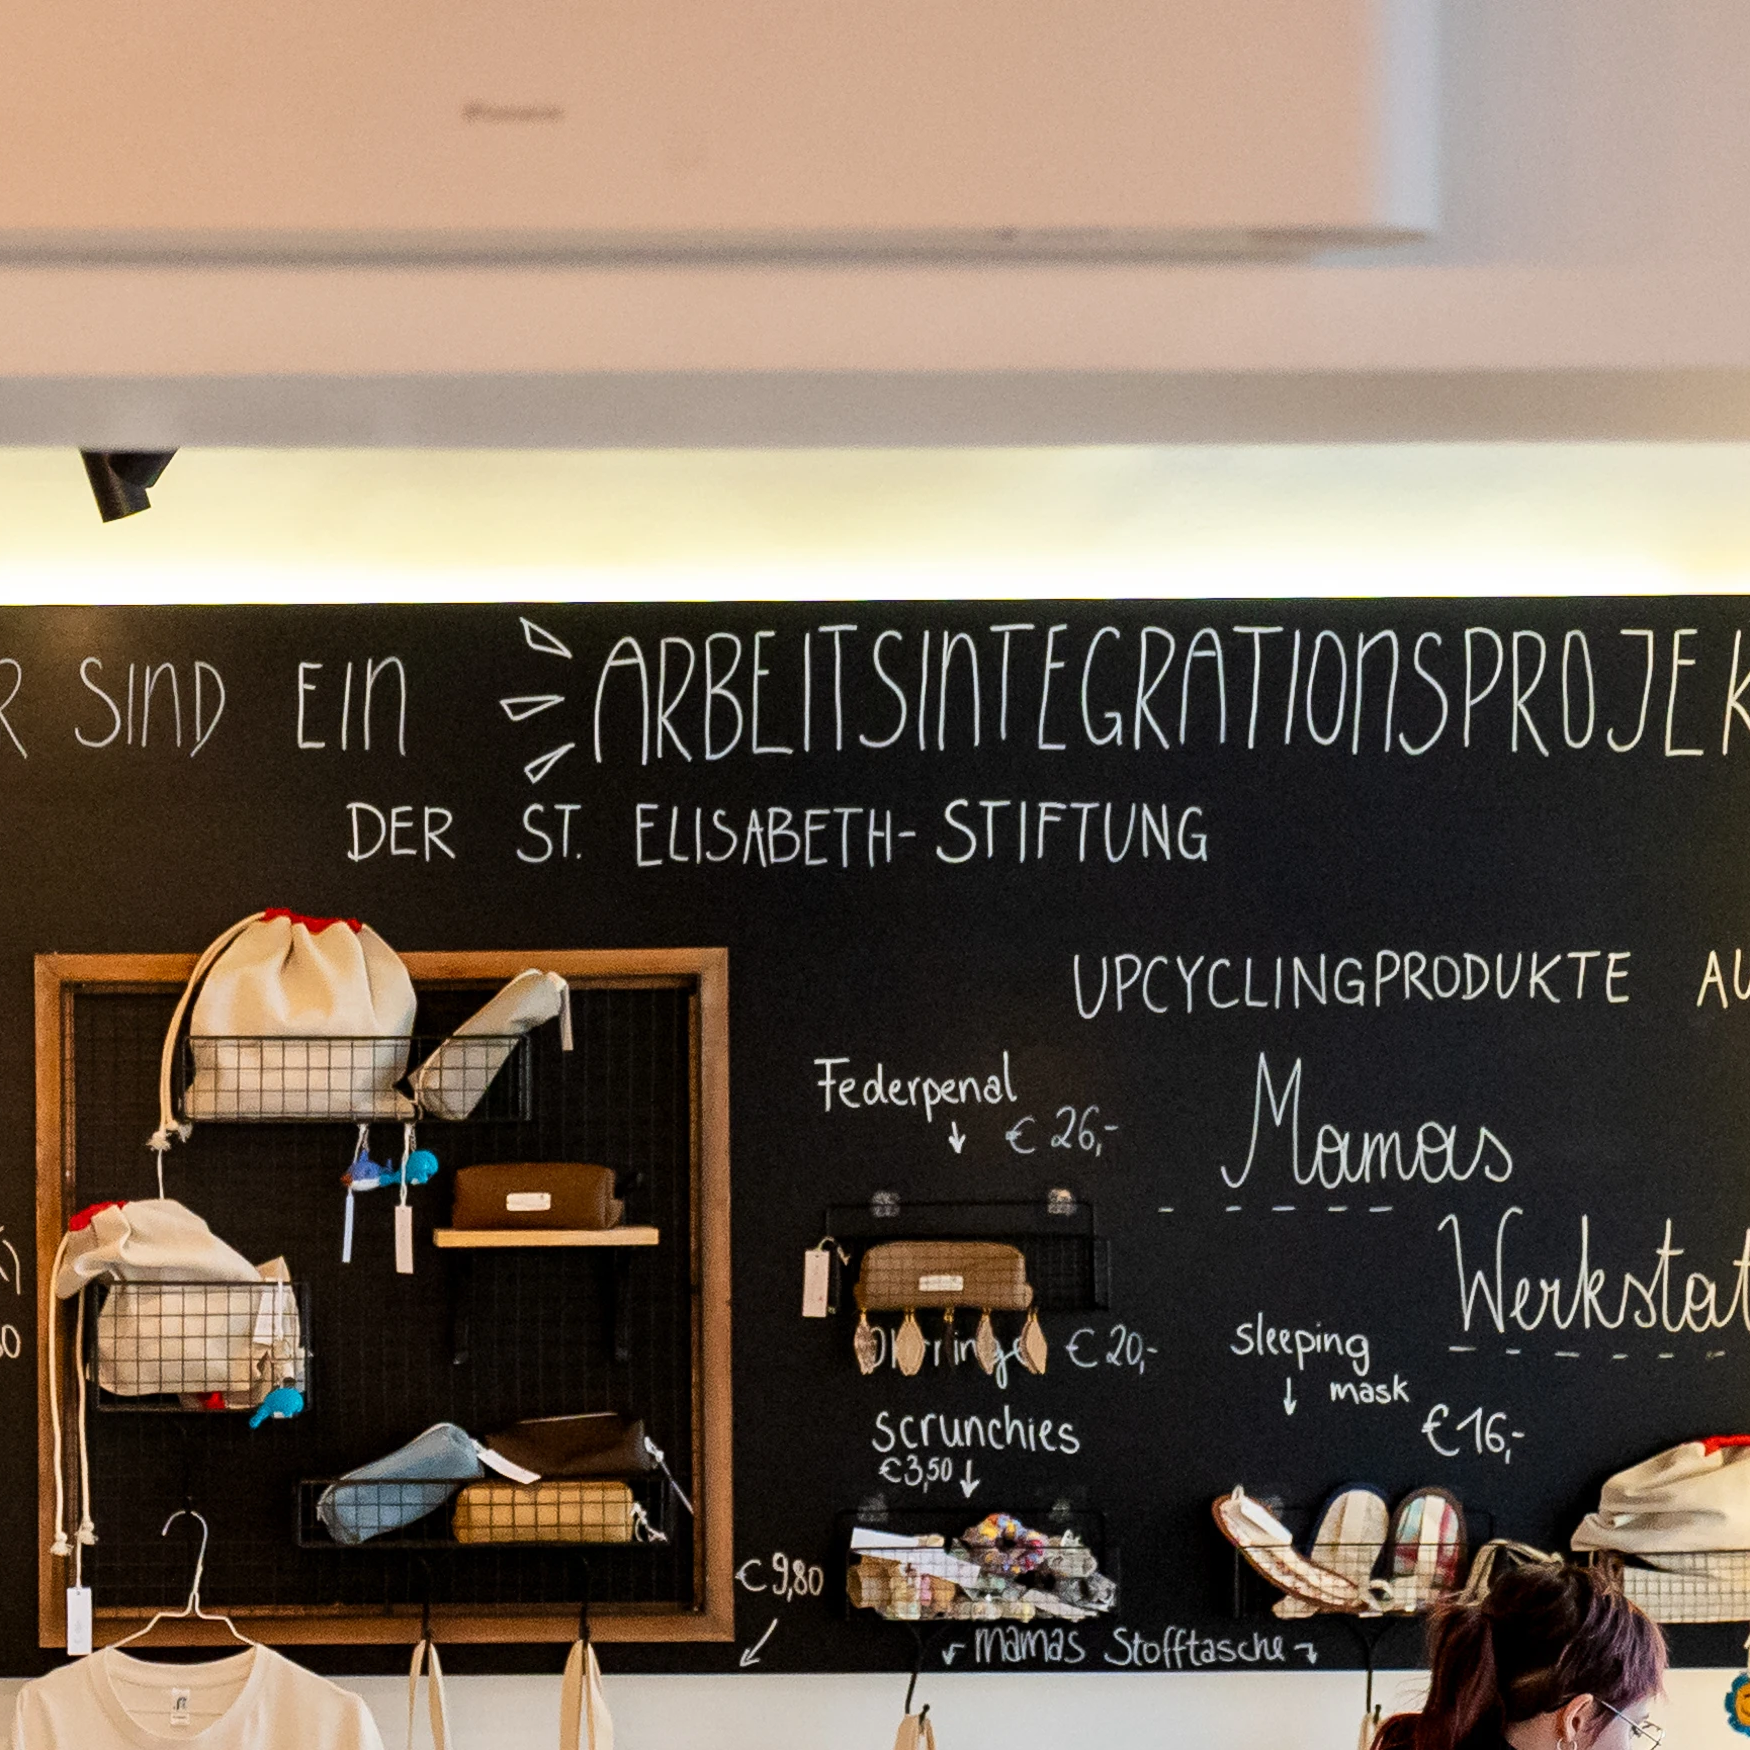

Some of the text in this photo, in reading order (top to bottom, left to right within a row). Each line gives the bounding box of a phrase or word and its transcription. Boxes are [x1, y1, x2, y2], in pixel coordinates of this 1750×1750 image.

[75, 657, 225, 757] SIND
[298, 657, 405, 755] EIN
[347, 802, 455, 862] DER
[517, 803, 581, 863] ST.
[1074, 950, 1630, 1019] UPCYCLINGPRODUKTE
[814, 1051, 1020, 1124] Federpenal
[1221, 1052, 1512, 1189] Mamas
[1330, 1374, 1409, 1404] mask
[1422, 1404, 1524, 1463] €16,-
[879, 1455, 952, 1492] €3,50
[1105, 1627, 1284, 1668] Stofftasche
